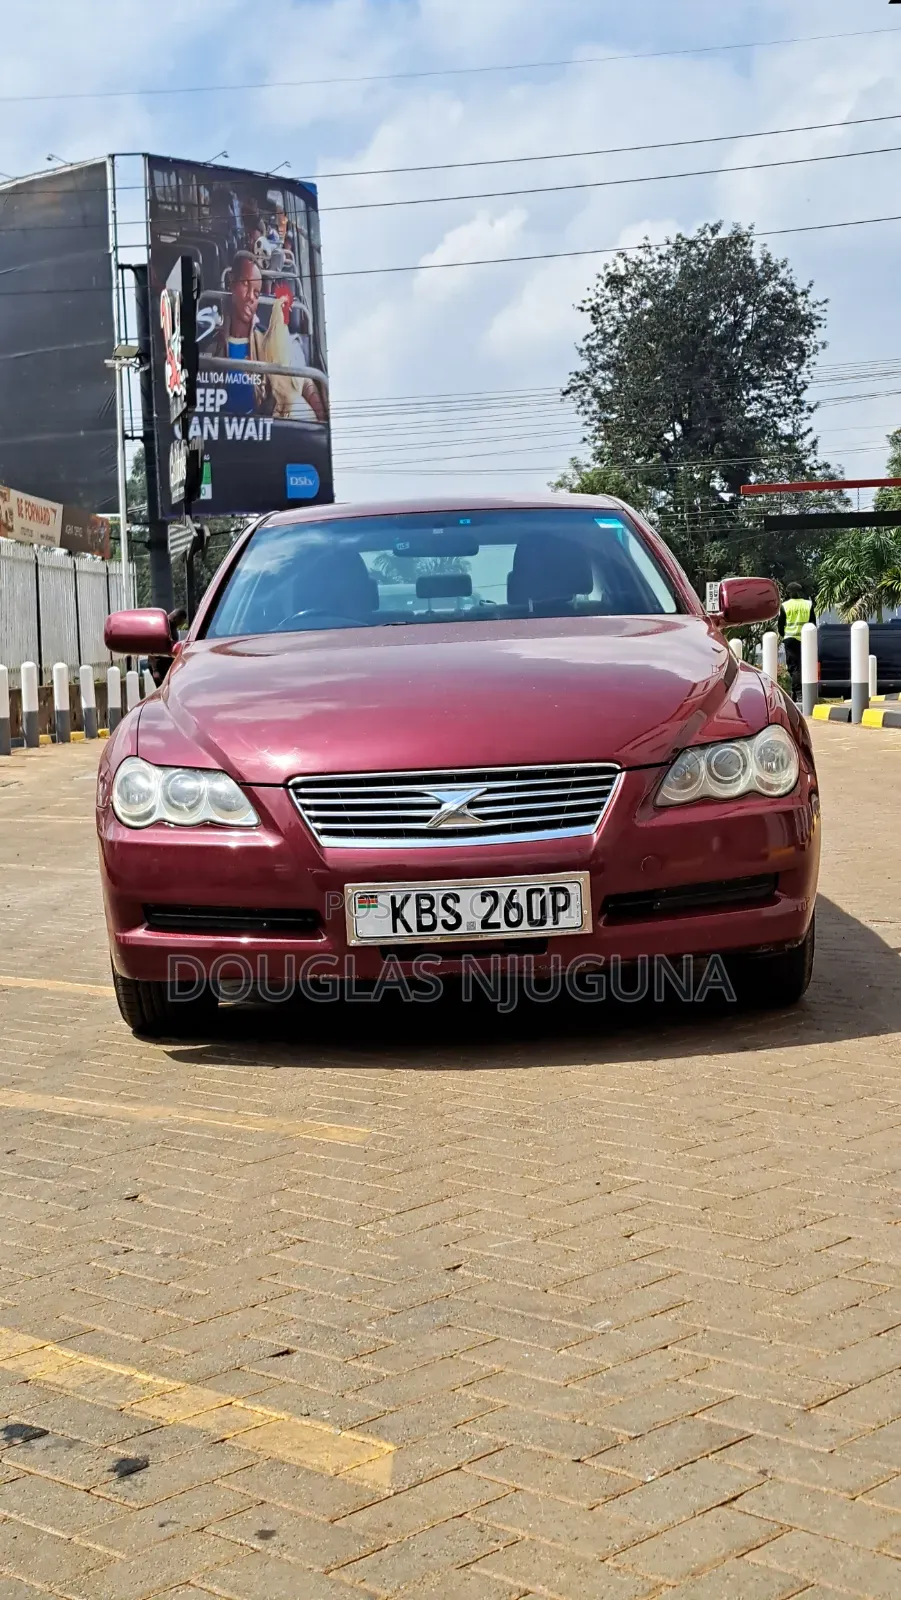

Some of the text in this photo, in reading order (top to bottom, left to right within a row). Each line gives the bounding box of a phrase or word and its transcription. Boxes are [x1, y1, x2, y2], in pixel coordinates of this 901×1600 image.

[196, 371, 262, 385] ALL 104 MATCHES
[195, 388, 228, 412] EEP
[224, 417, 273, 441] WAIT
[289, 476, 314, 486] DStv
[25, 500, 50, 526] FORWARD
[390, 891, 464, 934] KBS
[480, 886, 570, 930] 260P
